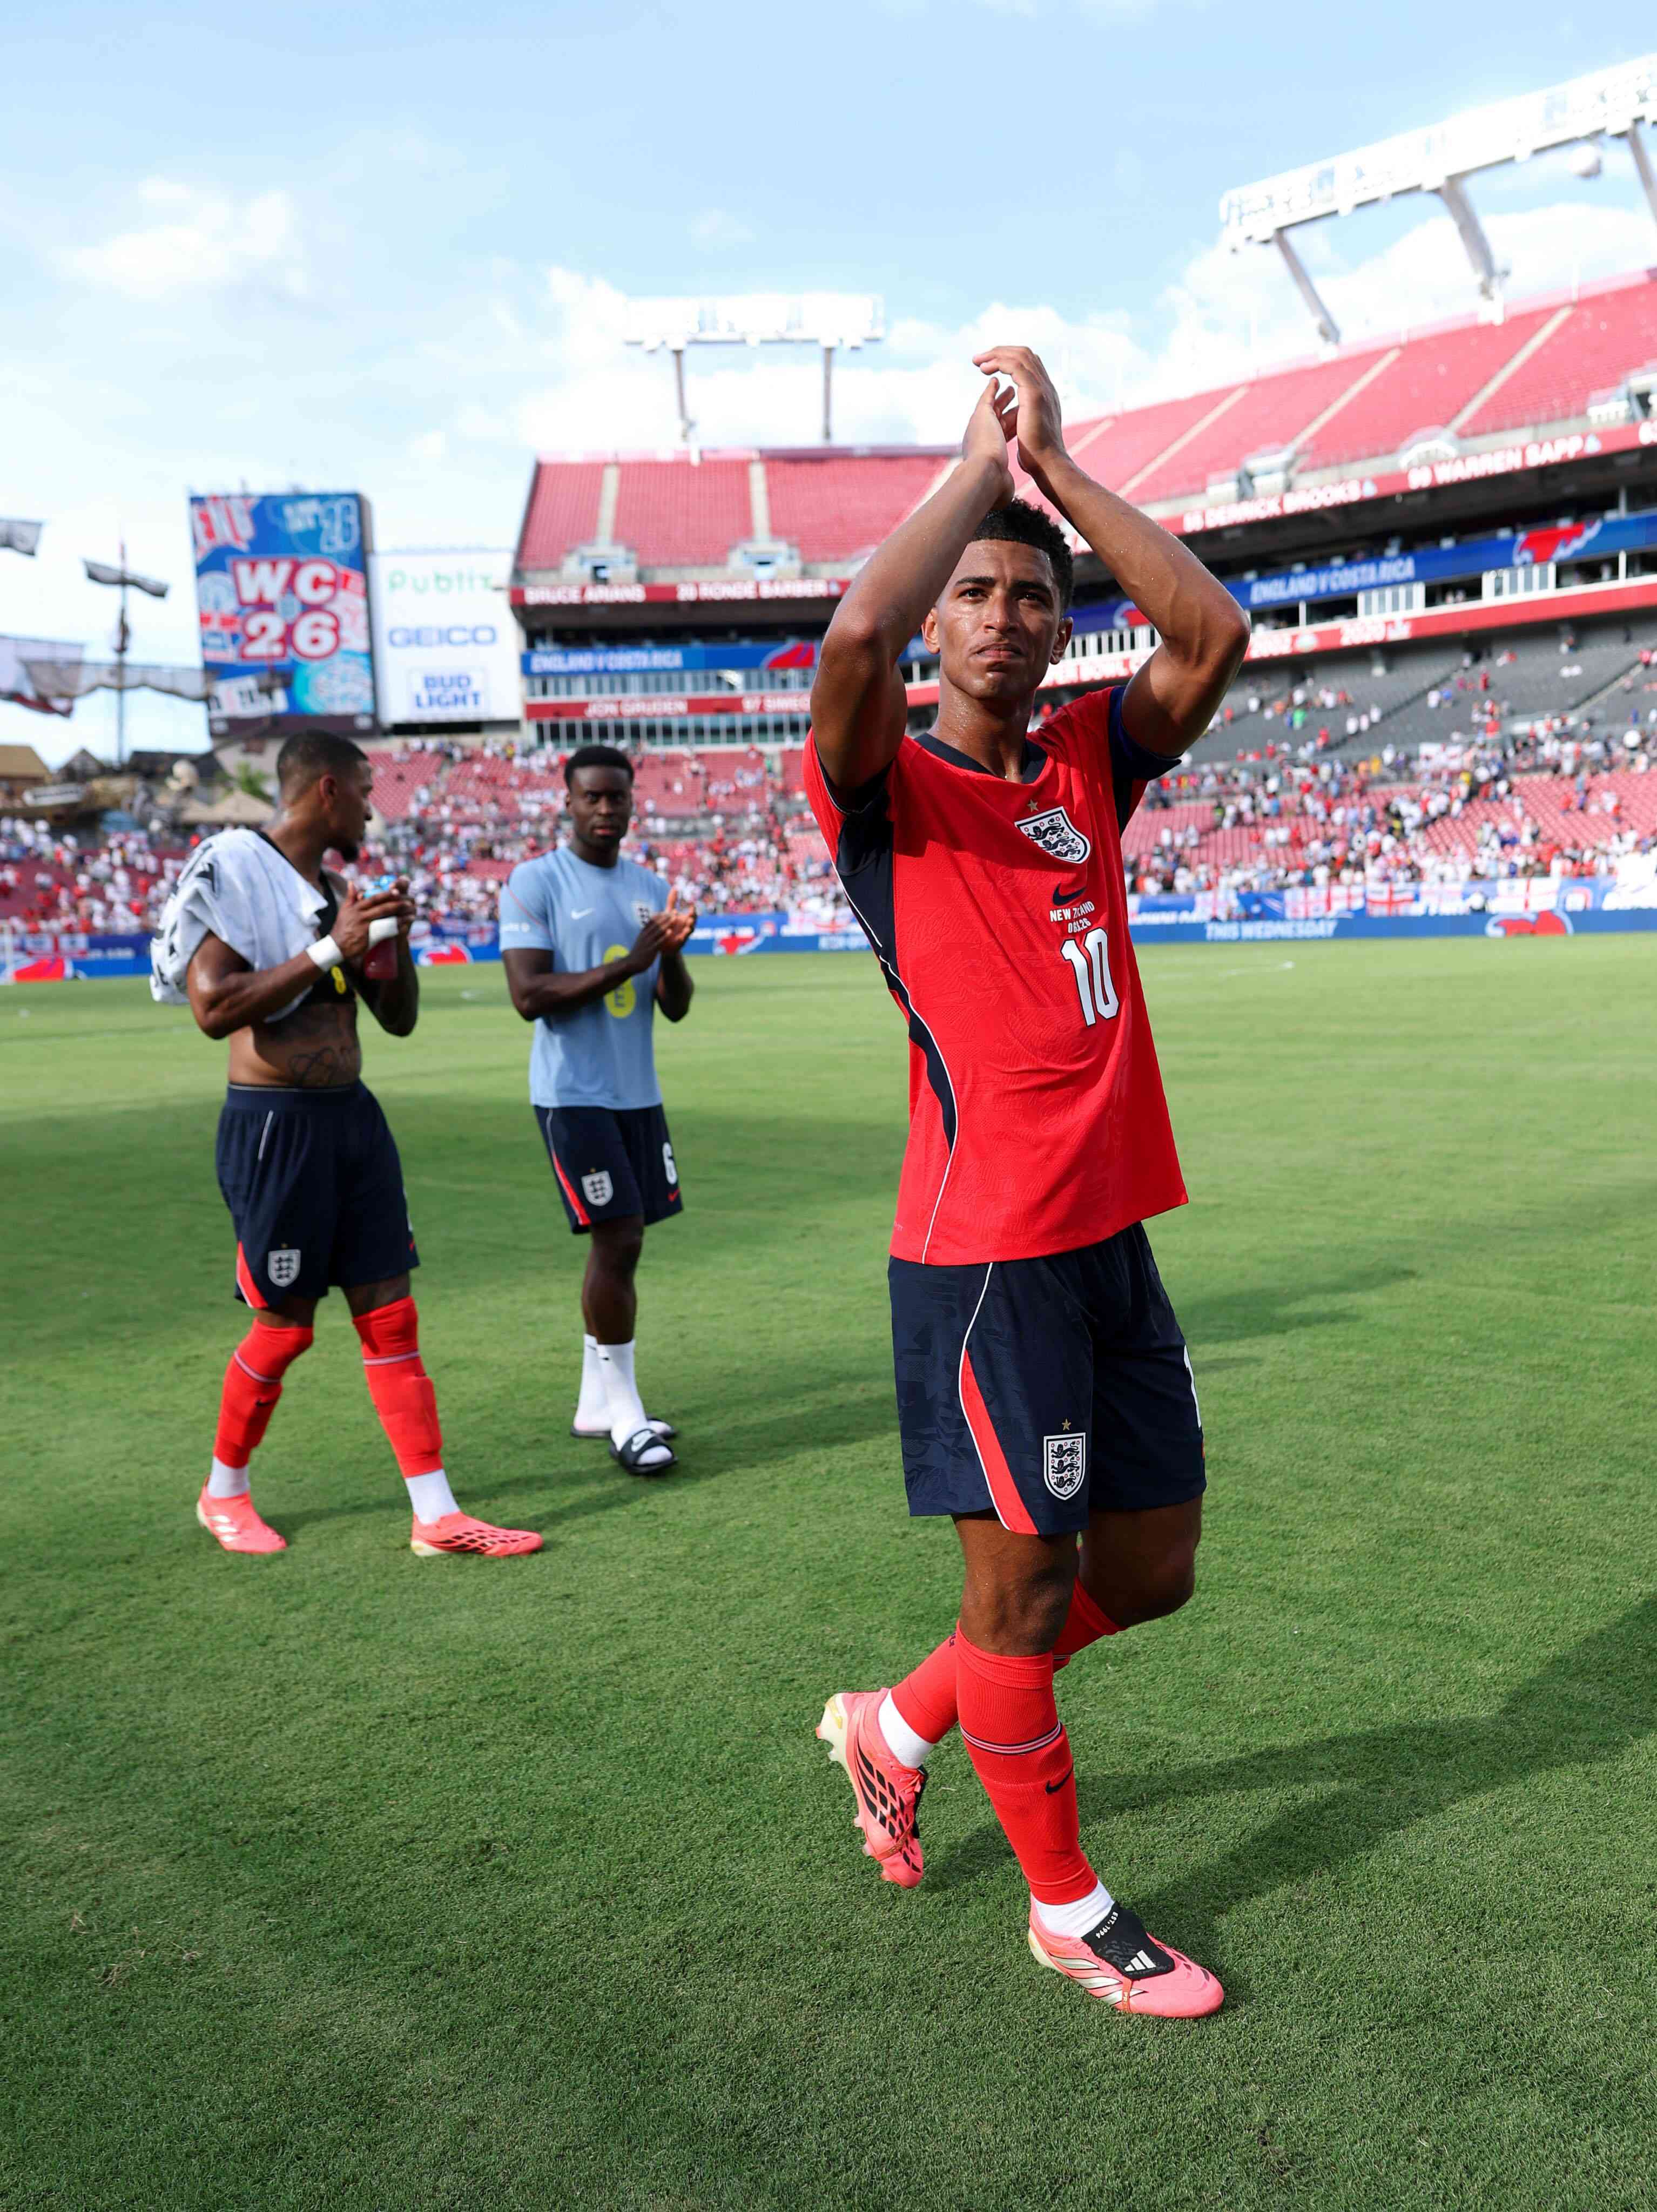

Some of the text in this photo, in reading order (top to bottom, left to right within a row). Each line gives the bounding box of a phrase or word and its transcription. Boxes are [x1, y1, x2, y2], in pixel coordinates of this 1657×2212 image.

[1434, 449, 1523, 484] WARREN
[1525, 435, 1584, 467] SAPP
[1204, 497, 1283, 528] DERRICK
[1283, 480, 1360, 513] BROOKS
[232, 558, 338, 605] WC
[698, 582, 756, 600] RONDE
[759, 579, 829, 598] BARBER
[1250, 556, 1415, 605] ENGLAND V COSTA RICA
[524, 583, 646, 604] BRUCE ARIANS
[240, 610, 340, 660] 26
[388, 625, 497, 648] GEICO
[530, 652, 594, 673] ENGLAND
[606, 652, 649, 671] COSTA
[651, 651, 683, 669] RICA
[424, 675, 471, 689] BUD
[415, 691, 480, 709] LIGHT
[1049, 908, 1072, 922] NEW
[1206, 920, 1338, 941] THIS WEDNESDAY
[1060, 927, 1119, 1028] 10
[662, 1142, 678, 1185] 6
[1107, 1912, 1119, 1925] EST.
[1095, 1925, 1110, 1939] 1994
